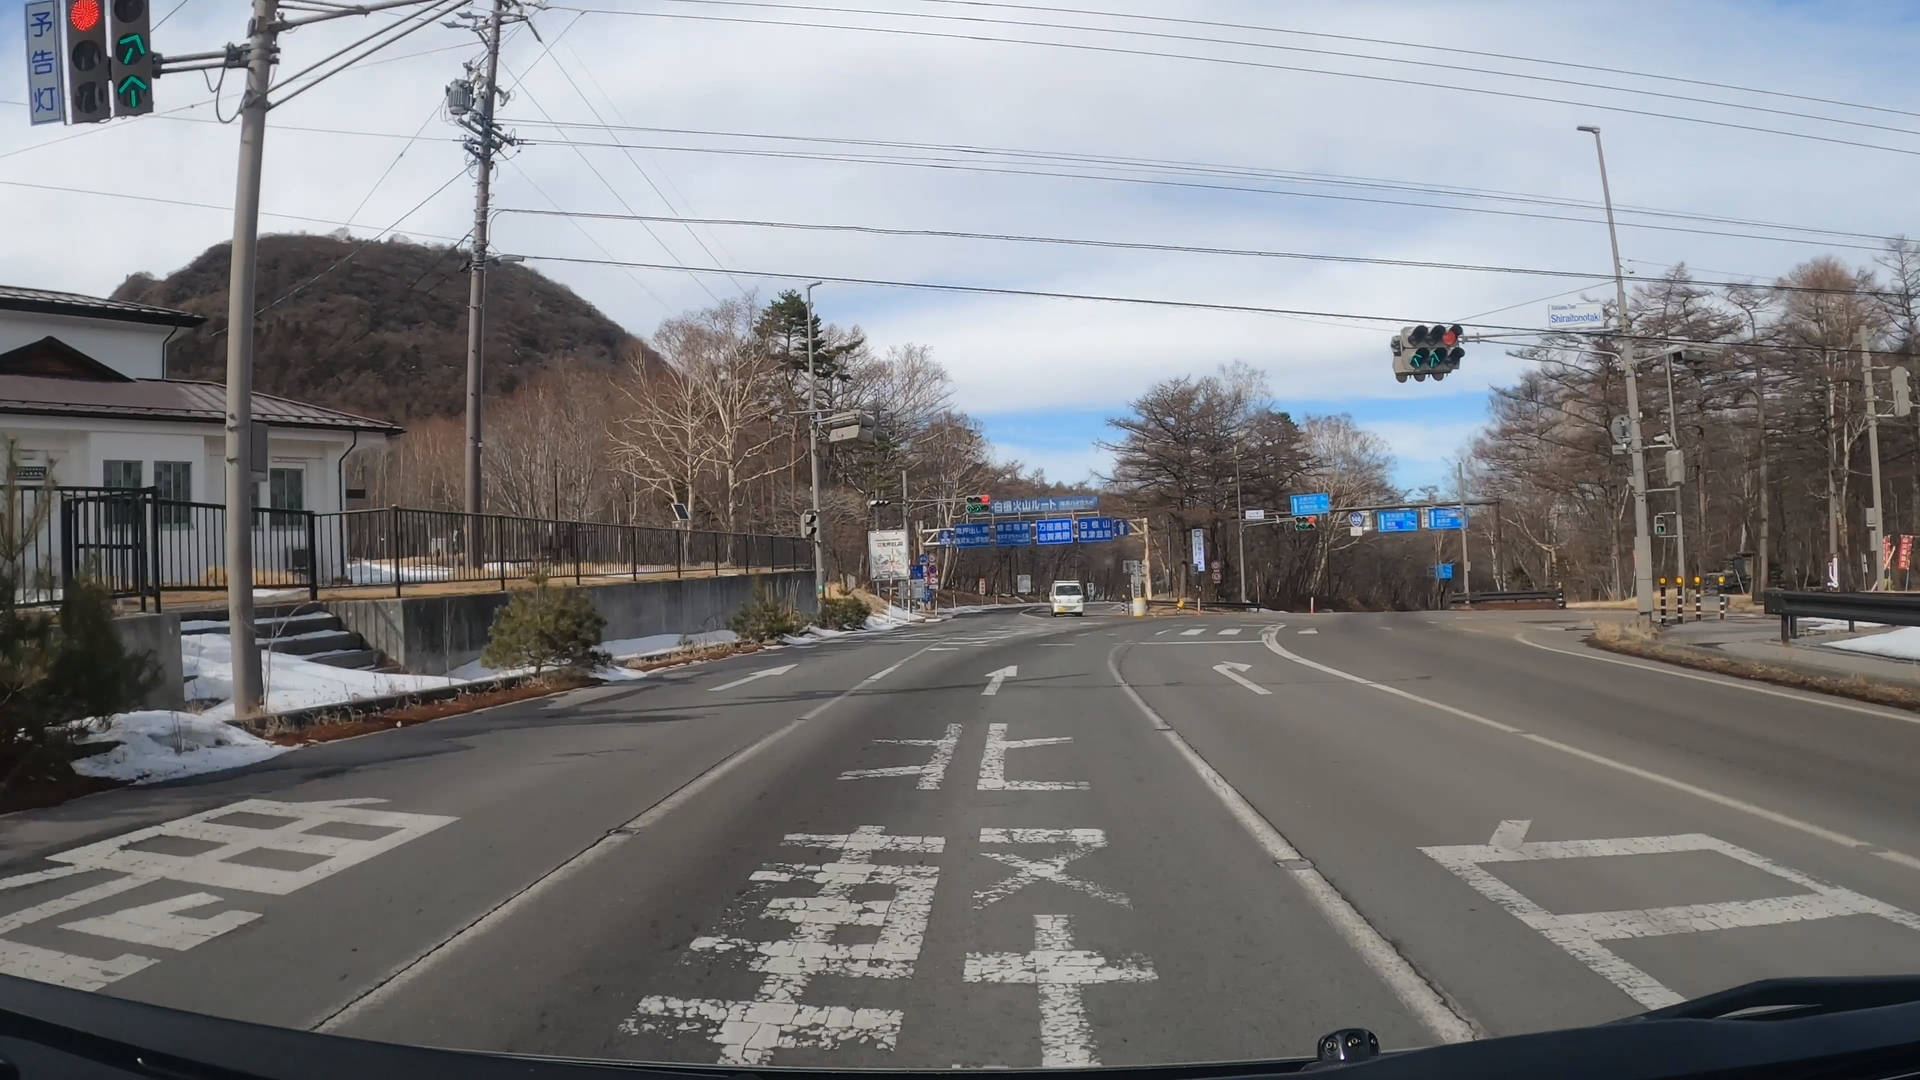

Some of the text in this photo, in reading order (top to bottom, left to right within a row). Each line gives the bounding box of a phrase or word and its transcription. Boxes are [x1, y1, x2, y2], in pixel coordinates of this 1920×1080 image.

[30, 11, 56, 112] 予告灯
[1551, 313, 1600, 322] Shiraitonotaki
[1080, 520, 1110, 529] 白根山
